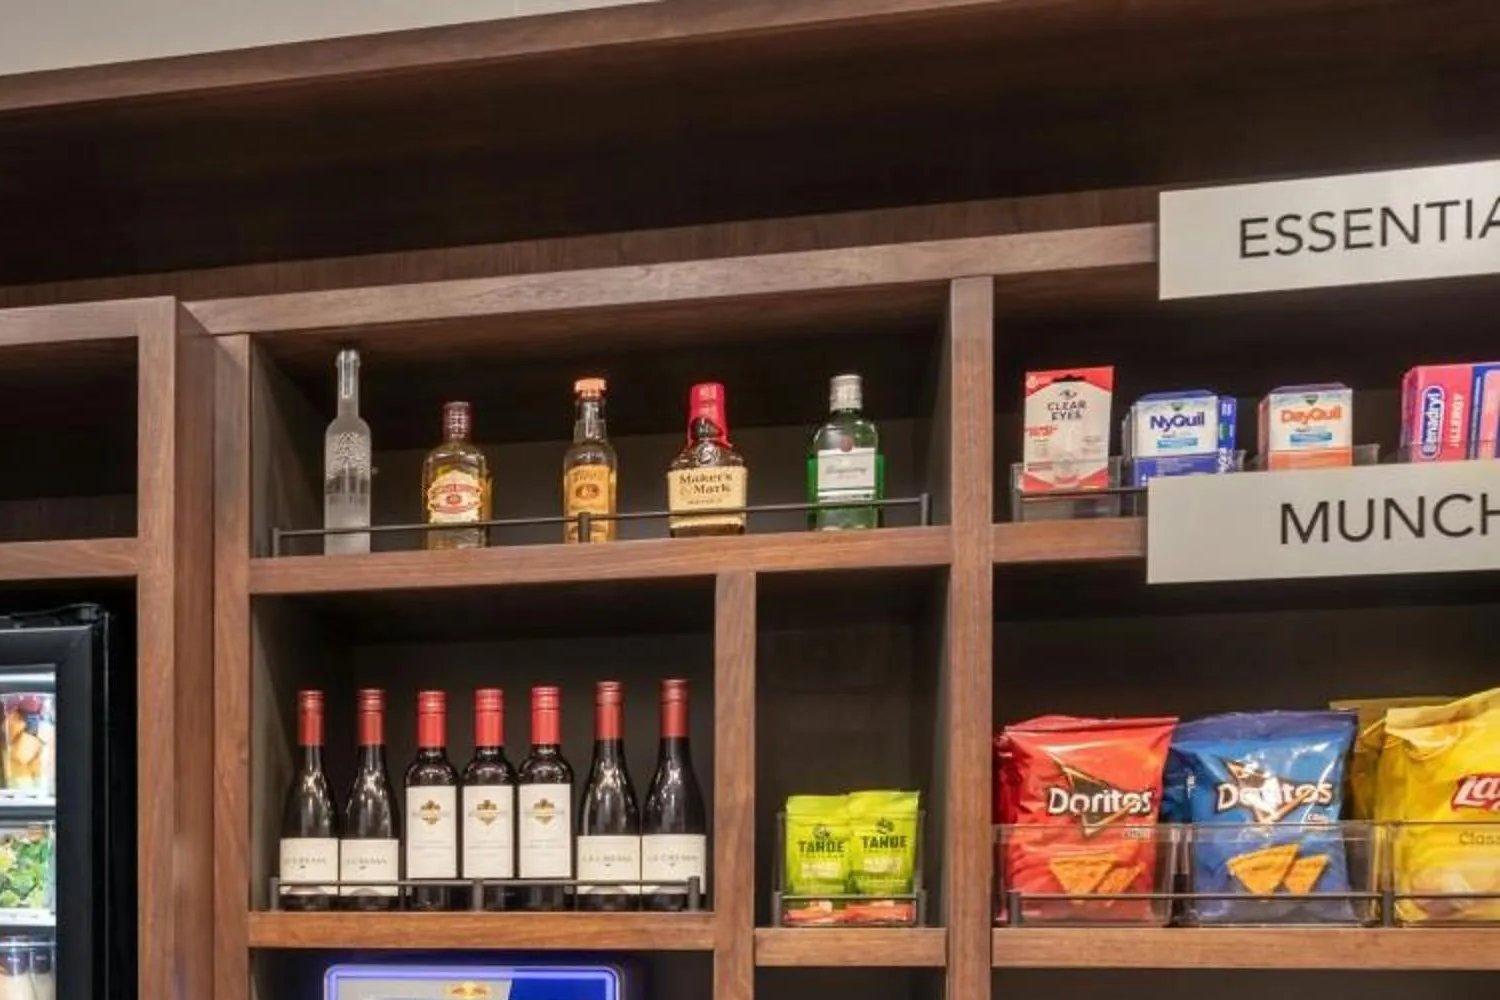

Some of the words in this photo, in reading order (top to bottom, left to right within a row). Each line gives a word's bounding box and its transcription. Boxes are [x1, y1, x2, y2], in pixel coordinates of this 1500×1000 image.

[1047, 400, 1086, 411] CLEAR
[1051, 411, 1082, 421] EYES
[1150, 411, 1205, 432] NyQuil
[1280, 406, 1341, 424] DayQuil
[679, 473, 733, 485] Maker's
[694, 484, 731, 494] Mark
[1049, 787, 1153, 815] Doritos
[798, 840, 845, 853] TAHOE
[861, 835, 908, 849] TAHOE
